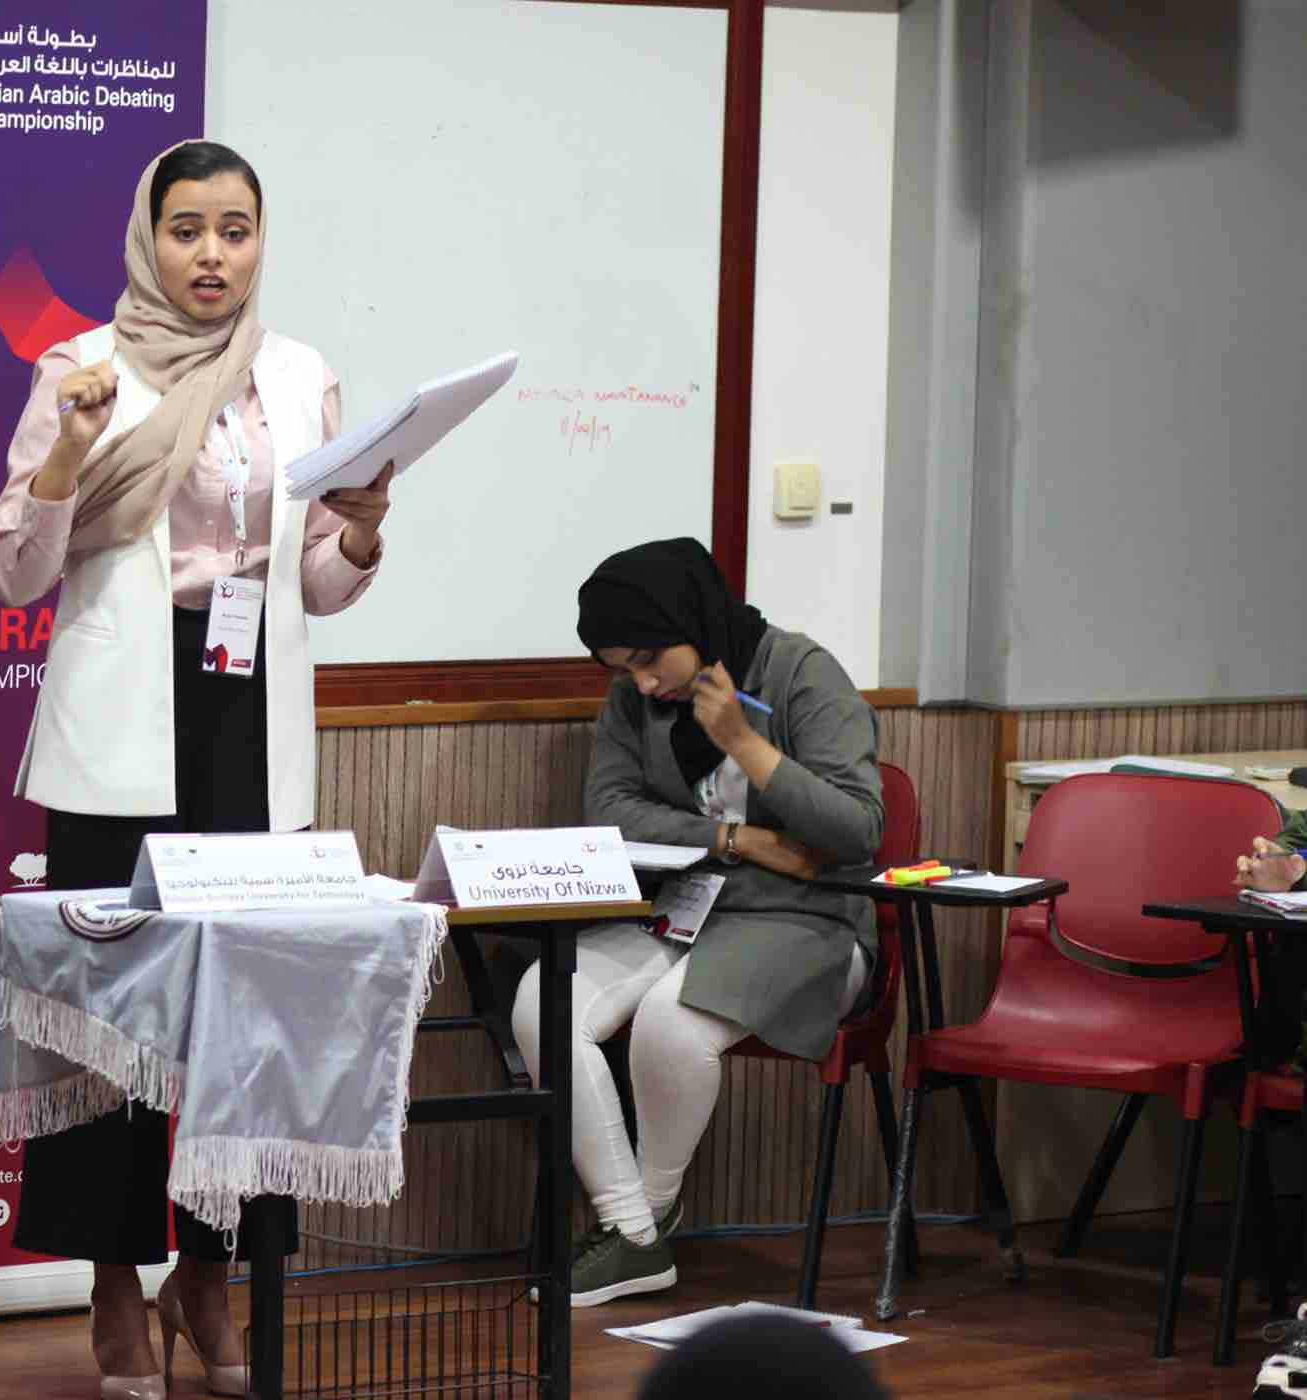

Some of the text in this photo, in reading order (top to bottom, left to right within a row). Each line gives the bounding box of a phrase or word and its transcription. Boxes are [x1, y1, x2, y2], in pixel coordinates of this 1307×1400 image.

[27, 25, 97, 52] بطولة
[34, 54, 88, 80] باللغة
[91, 58, 175, 80] للمناظرات
[29, 83, 90, 105] Arabic
[95, 85, 175, 112] Debating
[529, 861, 584, 877] جامعة
[468, 880, 628, 901] University Of Nizwa
